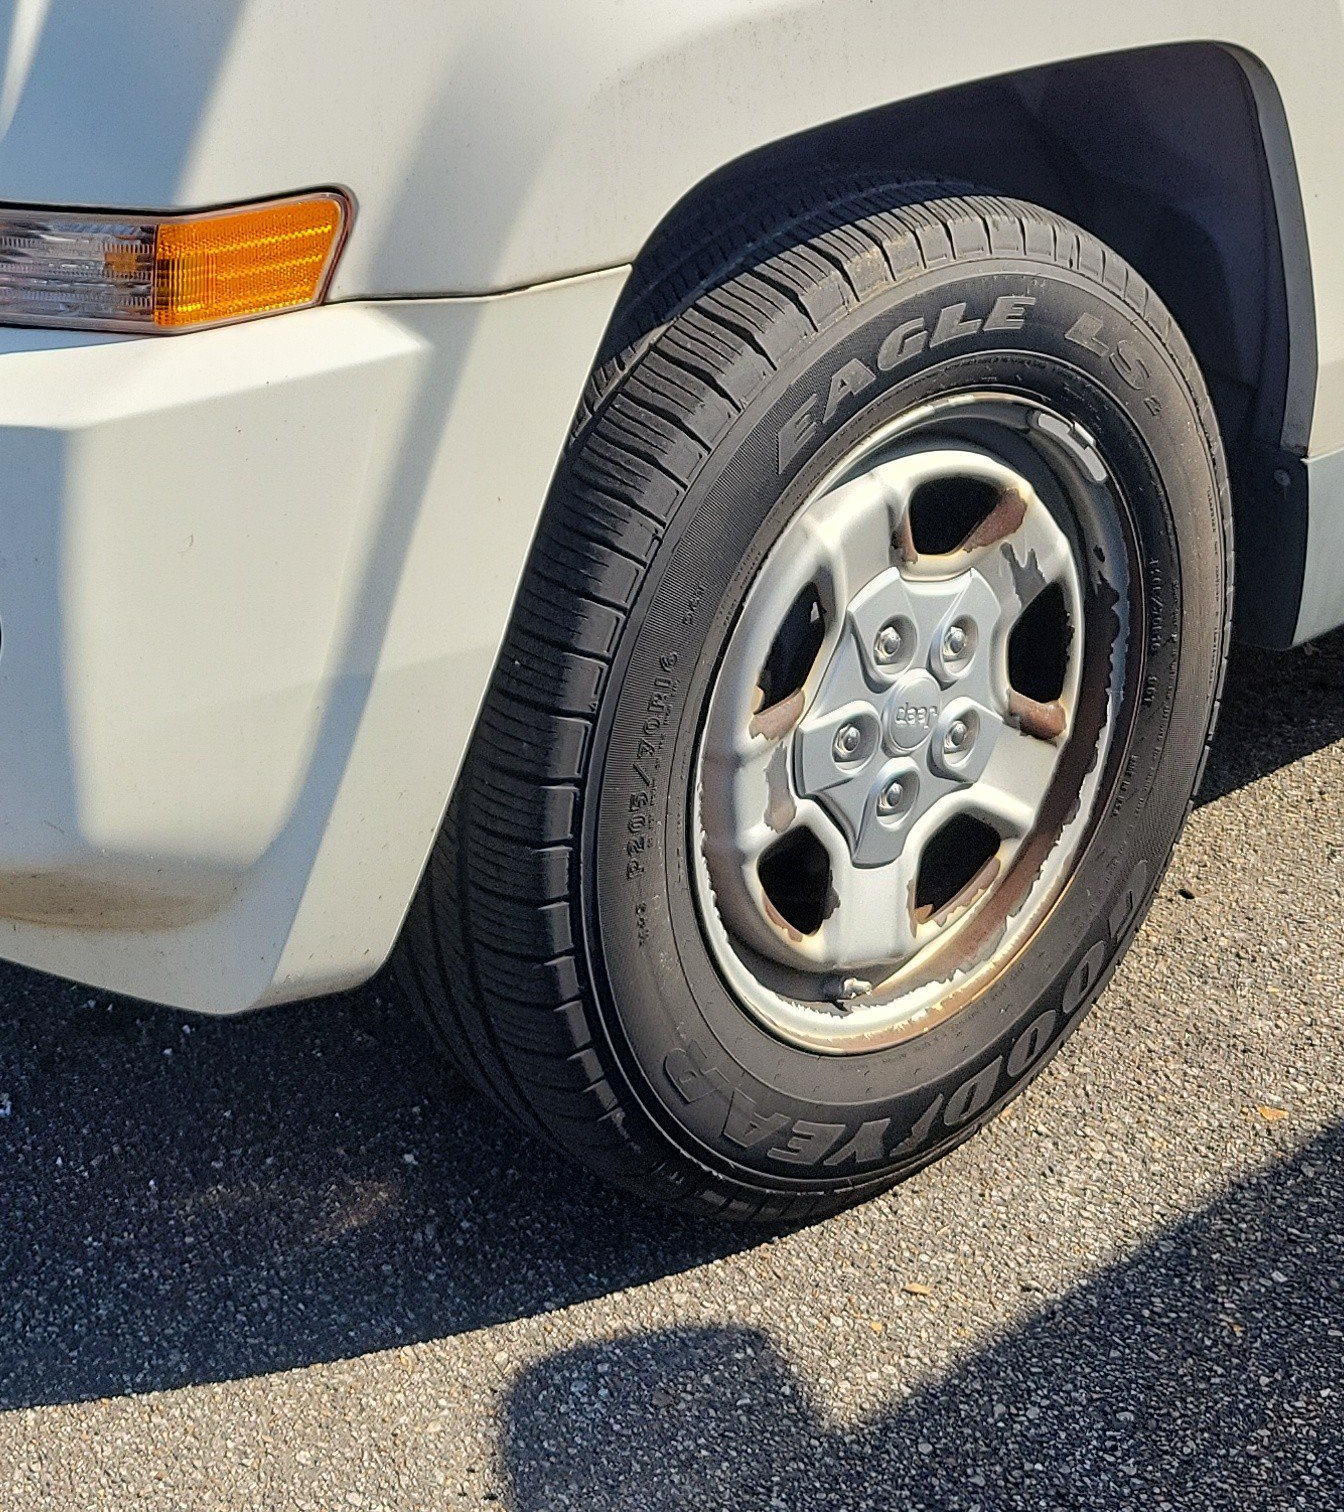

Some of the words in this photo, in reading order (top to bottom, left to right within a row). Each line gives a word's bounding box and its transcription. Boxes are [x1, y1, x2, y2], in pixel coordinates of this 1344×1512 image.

[777, 295, 1036, 475] EAGLE
[626, 650, 679, 881] P205/70R16
[663, 859, 1148, 1166] GOODYEAR
